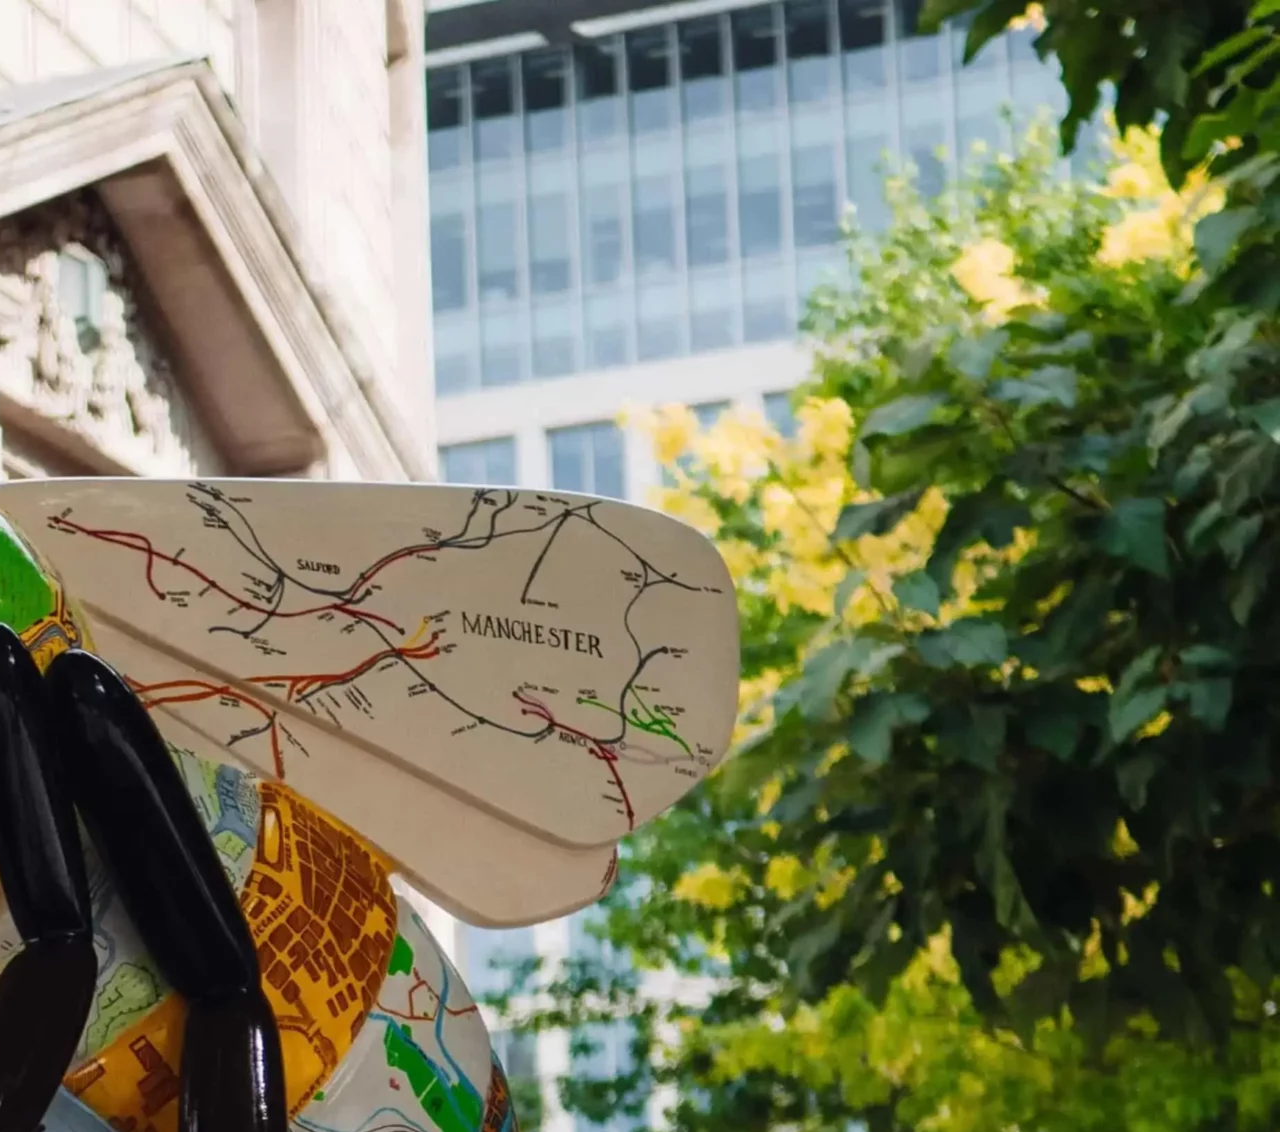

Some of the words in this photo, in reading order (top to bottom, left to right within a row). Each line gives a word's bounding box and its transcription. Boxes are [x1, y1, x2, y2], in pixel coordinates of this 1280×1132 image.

[296, 558, 341, 575] SALFORD
[461, 611, 604, 659] MANCHESTER
[253, 892, 295, 939] ICCADILLY
